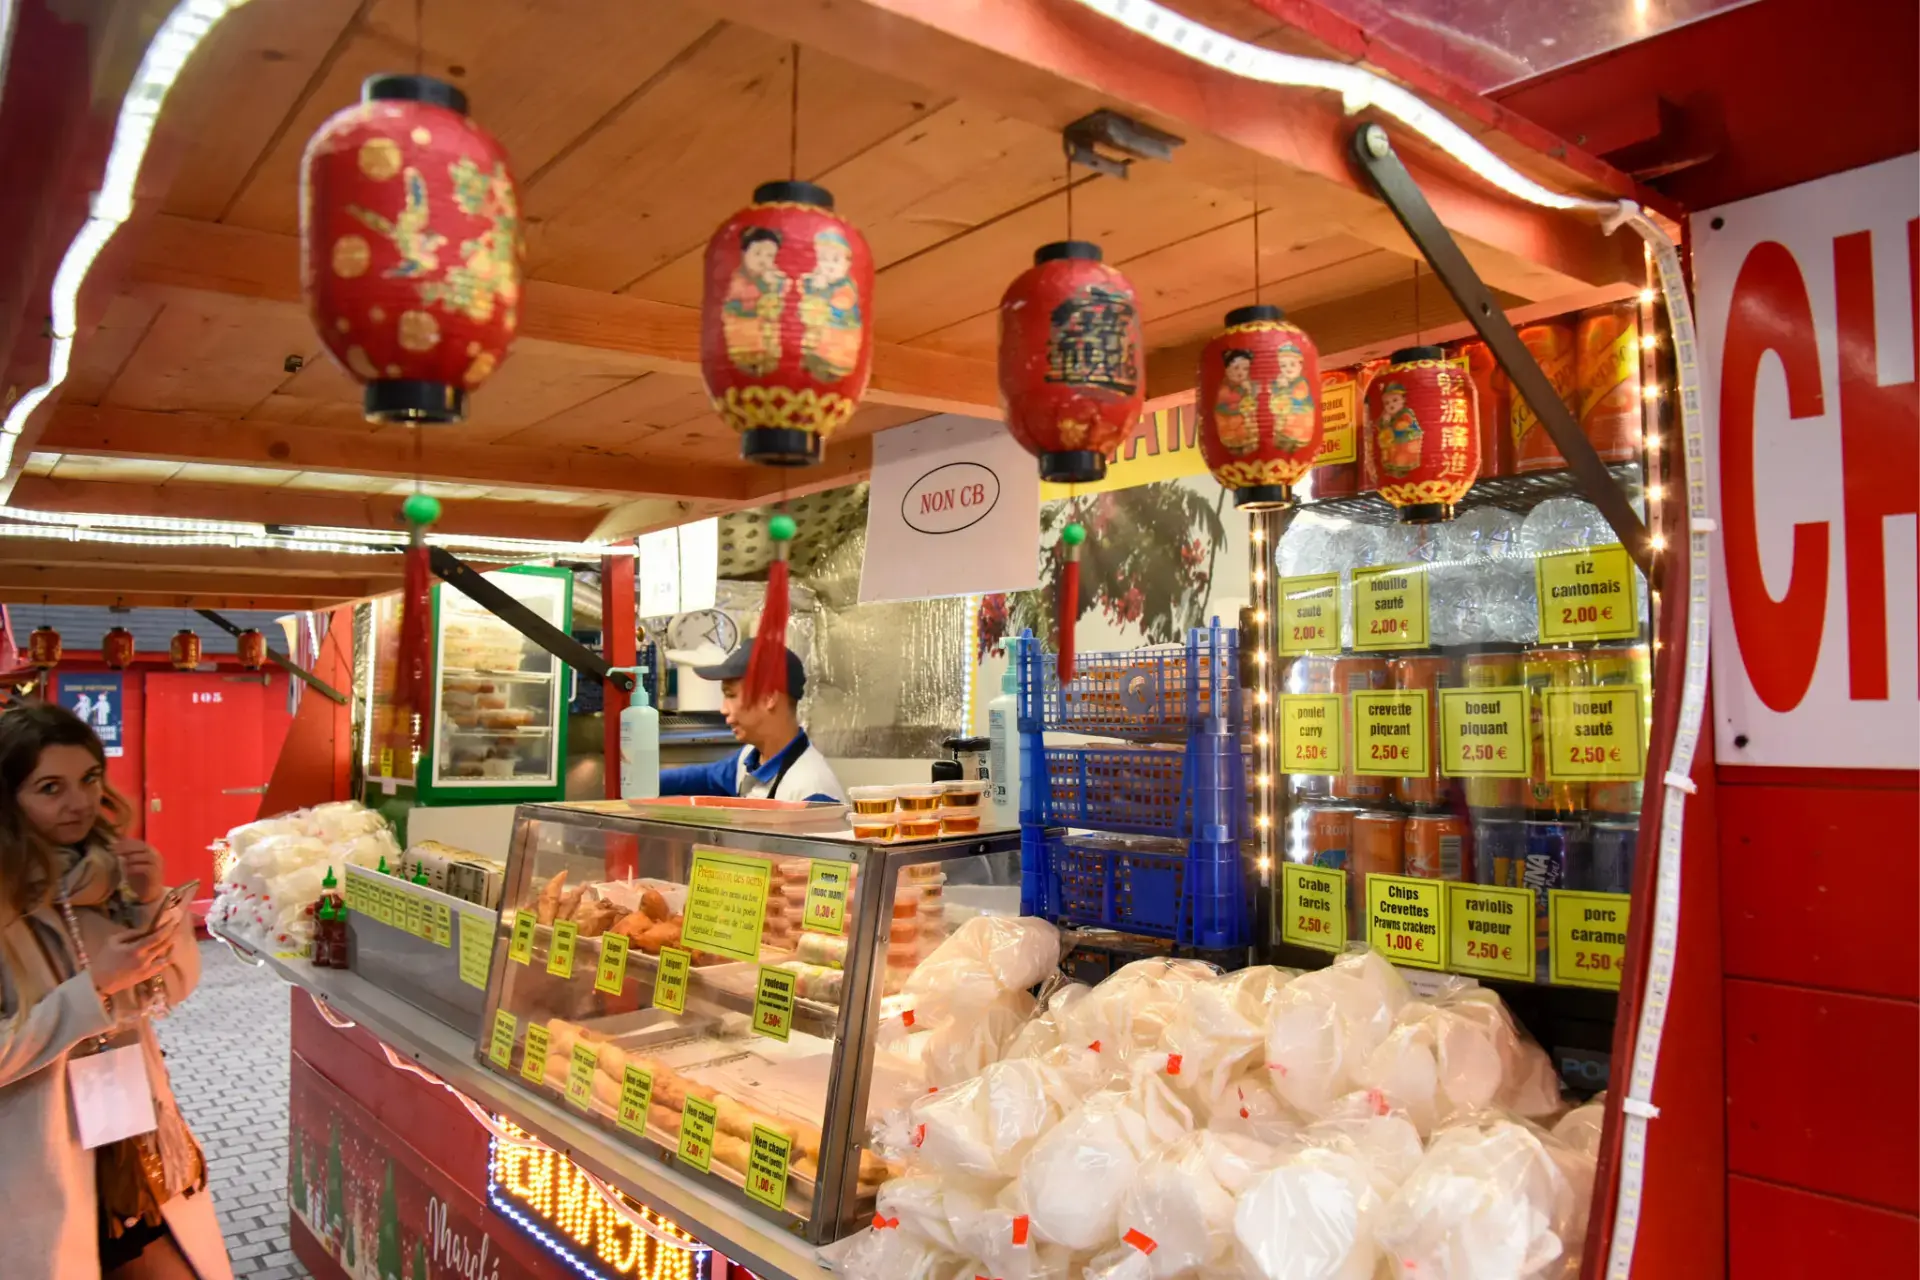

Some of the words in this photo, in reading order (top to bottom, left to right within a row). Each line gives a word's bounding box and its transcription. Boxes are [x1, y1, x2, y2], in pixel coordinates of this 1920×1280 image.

[919, 488, 955, 515] NON
[959, 484, 986, 507] CB
[1574, 560, 1595, 575] riz
[1370, 576, 1408, 592] nouille
[1550, 580, 1621, 599] cantonais
[1296, 605, 1322, 618] sauté
[1374, 595, 1404, 611] sauté
[1562, 606, 1599, 625] 2,00
[1599, 606, 1613, 621] €
[1293, 626, 1316, 641] 2,00
[1316, 627, 1325, 638] €
[1369, 618, 1398, 635] 2,00
[1399, 619, 1409, 632] €
[192, 691, 223, 704] 105
[1297, 704, 1326, 720] poulet
[1367, 703, 1412, 718] crevette
[1465, 699, 1502, 715] boeuf
[1573, 699, 1613, 716] boeuf
[1299, 724, 1323, 738] curry
[1370, 721, 1411, 737] piquant
[1460, 721, 1508, 738] piquant
[1574, 717, 1614, 738] sauté
[1295, 744, 1319, 760] 2,50
[1318, 745, 1328, 759] €
[1371, 744, 1398, 761] 2,50
[1400, 744, 1410, 759] €
[1461, 744, 1494, 762] 2,50
[1496, 744, 1508, 760] €
[1569, 745, 1606, 764] 2,50
[1608, 746, 1621, 763] €
[821, 872, 839, 883] sauce
[1298, 876, 1332, 895] Crabe
[1388, 885, 1419, 901] Chips
[815, 904, 831, 918] 0,30
[830, 908, 836, 919] €
[1298, 894, 1331, 912] farcis
[1379, 900, 1429, 919] Crevettes
[1465, 896, 1513, 916] raviolis
[1584, 907, 1617, 923] porc
[1298, 915, 1322, 934] 2,50
[1322, 920, 1332, 935] €
[1374, 915, 1401, 932] Prawns
[1402, 920, 1436, 936] crackers
[1467, 918, 1512, 937] vapeur
[1385, 932, 1413, 951] 1,00
[1414, 936, 1425, 952] €
[1571, 928, 1626, 945] carame
[1466, 940, 1499, 960] 2,50
[1501, 946, 1513, 961] €
[1575, 951, 1611, 971] 2,50
[1614, 956, 1625, 971] €
[754, 1134, 768, 1150] Nem
[768, 1141, 787, 1158] chaud
[769, 1183, 776, 1195] €
